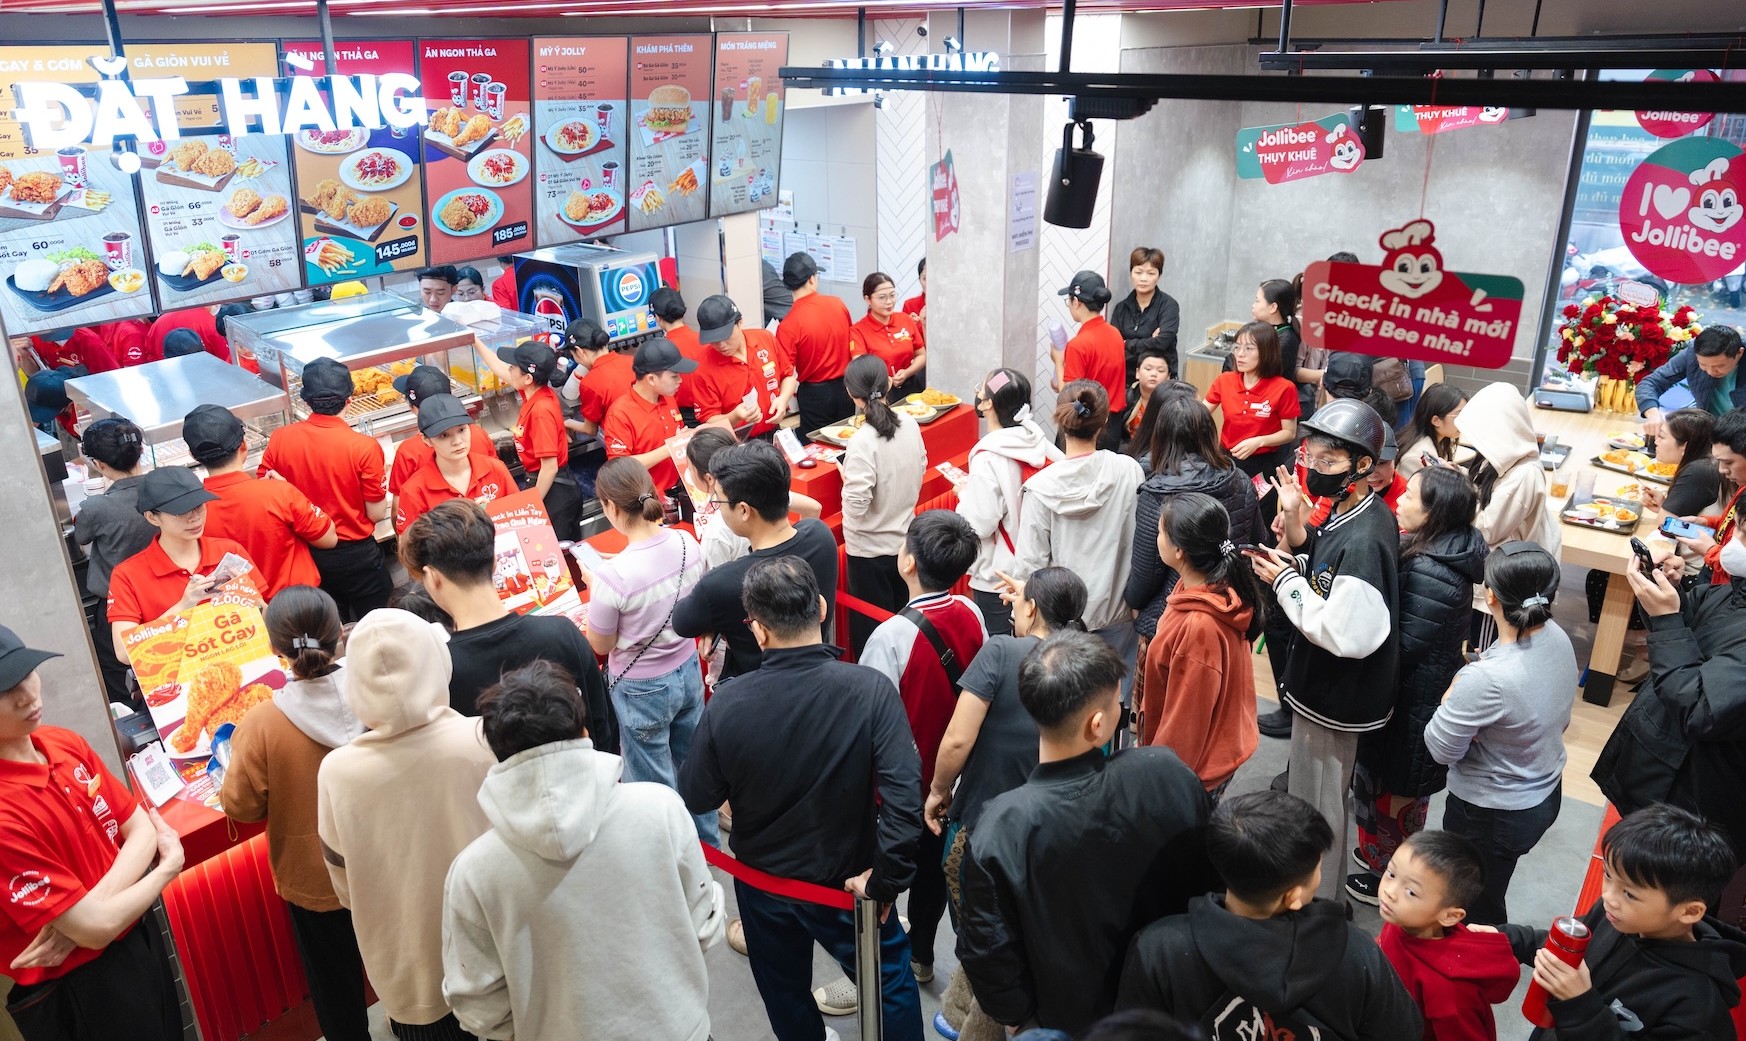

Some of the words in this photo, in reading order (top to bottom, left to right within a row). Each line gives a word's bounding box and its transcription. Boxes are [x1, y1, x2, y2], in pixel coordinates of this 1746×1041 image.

[425, 47, 438, 58] ĂN
[440, 48, 465, 57] NGON
[466, 44, 484, 57] THẢ
[484, 48, 497, 56] GA
[540, 45, 553, 56] MỲ
[554, 45, 561, 56] Ý
[561, 47, 586, 56] JOLLY
[636, 43, 658, 54] KHÁM
[659, 43, 673, 53] PHÁ
[674, 42, 694, 53] THÊM
[720, 41, 736, 51] MÓN
[737, 40, 757, 50] TRÁNG
[133, 53, 154, 68] GÀ
[155, 53, 188, 68] GIÒN
[190, 55, 212, 67] VUI
[213, 50, 230, 66] VẺ
[310, 50, 340, 60] NGN
[342, 47, 364, 60] THẢ
[364, 50, 379, 60] GA
[48, 57, 83, 71] CƠM
[578, 66, 587, 74] 50
[578, 80, 587, 88] 40
[219, 51, 428, 140] HÀNG
[1415, 110, 1441, 121] THỤY
[1442, 107, 1468, 118] KHUÊ
[1641, 110, 1699, 124] Jollibee
[1258, 127, 1316, 147] Jollibee
[1258, 151, 1286, 166] THỤY
[1288, 147, 1317, 162] KHUÊ
[547, 190, 557, 198] 73
[1639, 181, 1653, 217] I
[188, 200, 202, 210] 66
[192, 218, 204, 226] 33
[493, 227, 514, 242] 185
[1631, 219, 1736, 261] Jollibee
[12, 250, 28, 258] Cay
[32, 240, 49, 251] 60
[375, 242, 401, 260] 145
[621, 283, 641, 293] PEPSI
[1313, 282, 1386, 314] Check
[1388, 297, 1412, 320] in
[1414, 305, 1460, 330] nhà
[1463, 319, 1512, 341] mới
[1323, 309, 1378, 338] cùng
[1378, 319, 1420, 344] Bee
[1422, 333, 1475, 357] nha!
[214, 611, 242, 629] Gà
[127, 622, 173, 645] Jollibee
[184, 636, 219, 658] Sốt
[220, 624, 256, 645] Cay
[200, 650, 221, 662] NGON
[10, 874, 51, 904] Jollibee
